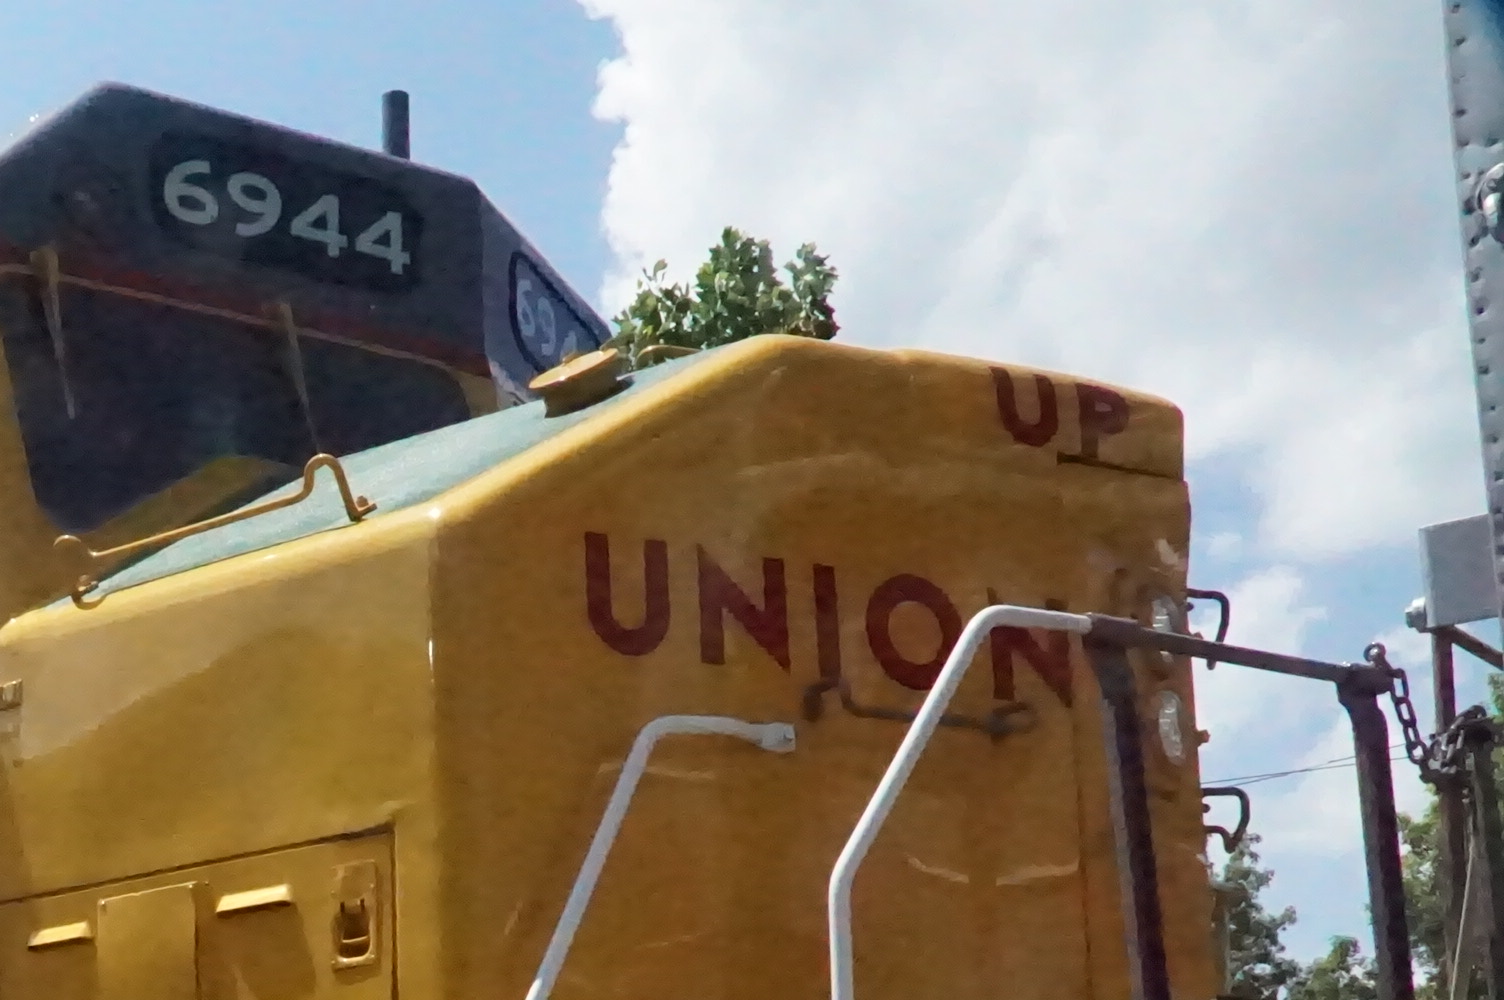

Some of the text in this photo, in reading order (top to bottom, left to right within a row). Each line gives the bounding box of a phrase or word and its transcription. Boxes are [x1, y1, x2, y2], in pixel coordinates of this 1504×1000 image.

[163, 159, 411, 275] 6944
[989, 366, 1129, 458] UP
[584, 531, 1073, 708] UNION
